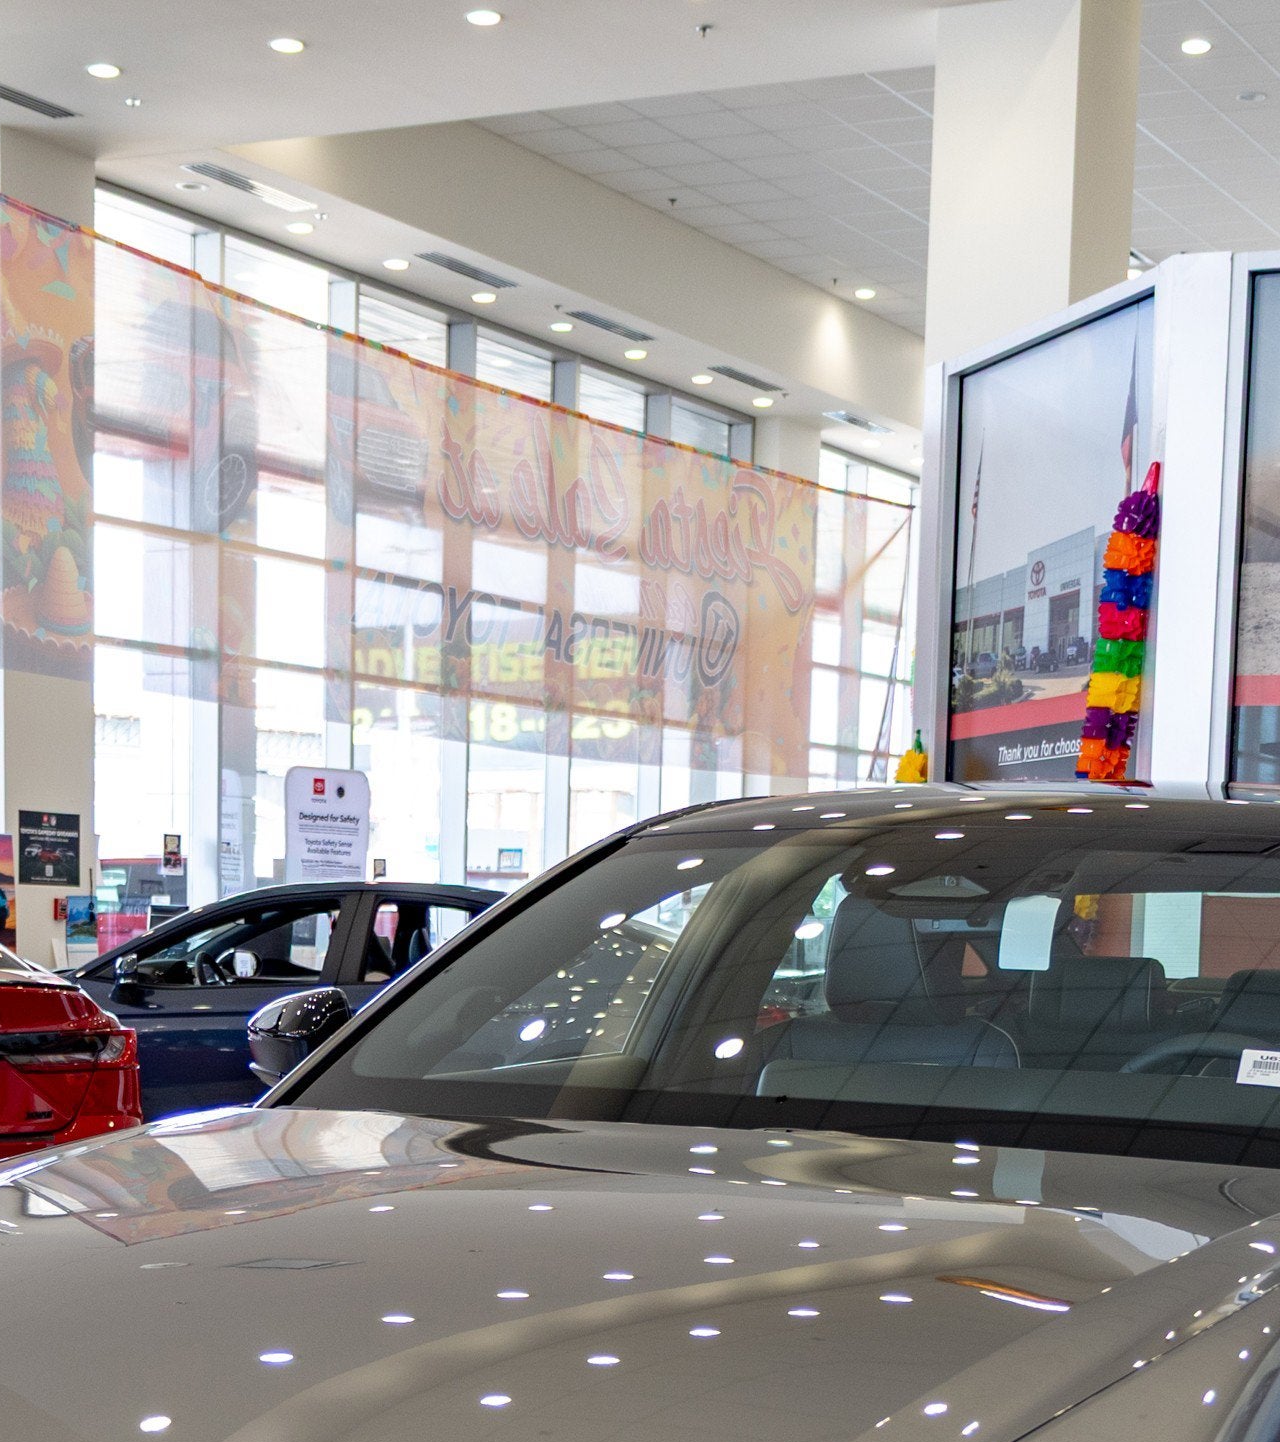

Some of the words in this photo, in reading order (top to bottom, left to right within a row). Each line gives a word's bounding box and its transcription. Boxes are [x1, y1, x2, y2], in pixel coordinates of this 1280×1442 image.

[998, 743, 1022, 765] Thank
[1022, 744, 1040, 763] you
[1040, 739, 1055, 757] for
[1054, 737, 1083, 756] choos
[299, 812, 329, 823] Designed
[330, 813, 339, 822] for
[339, 815, 360, 826] Safety
